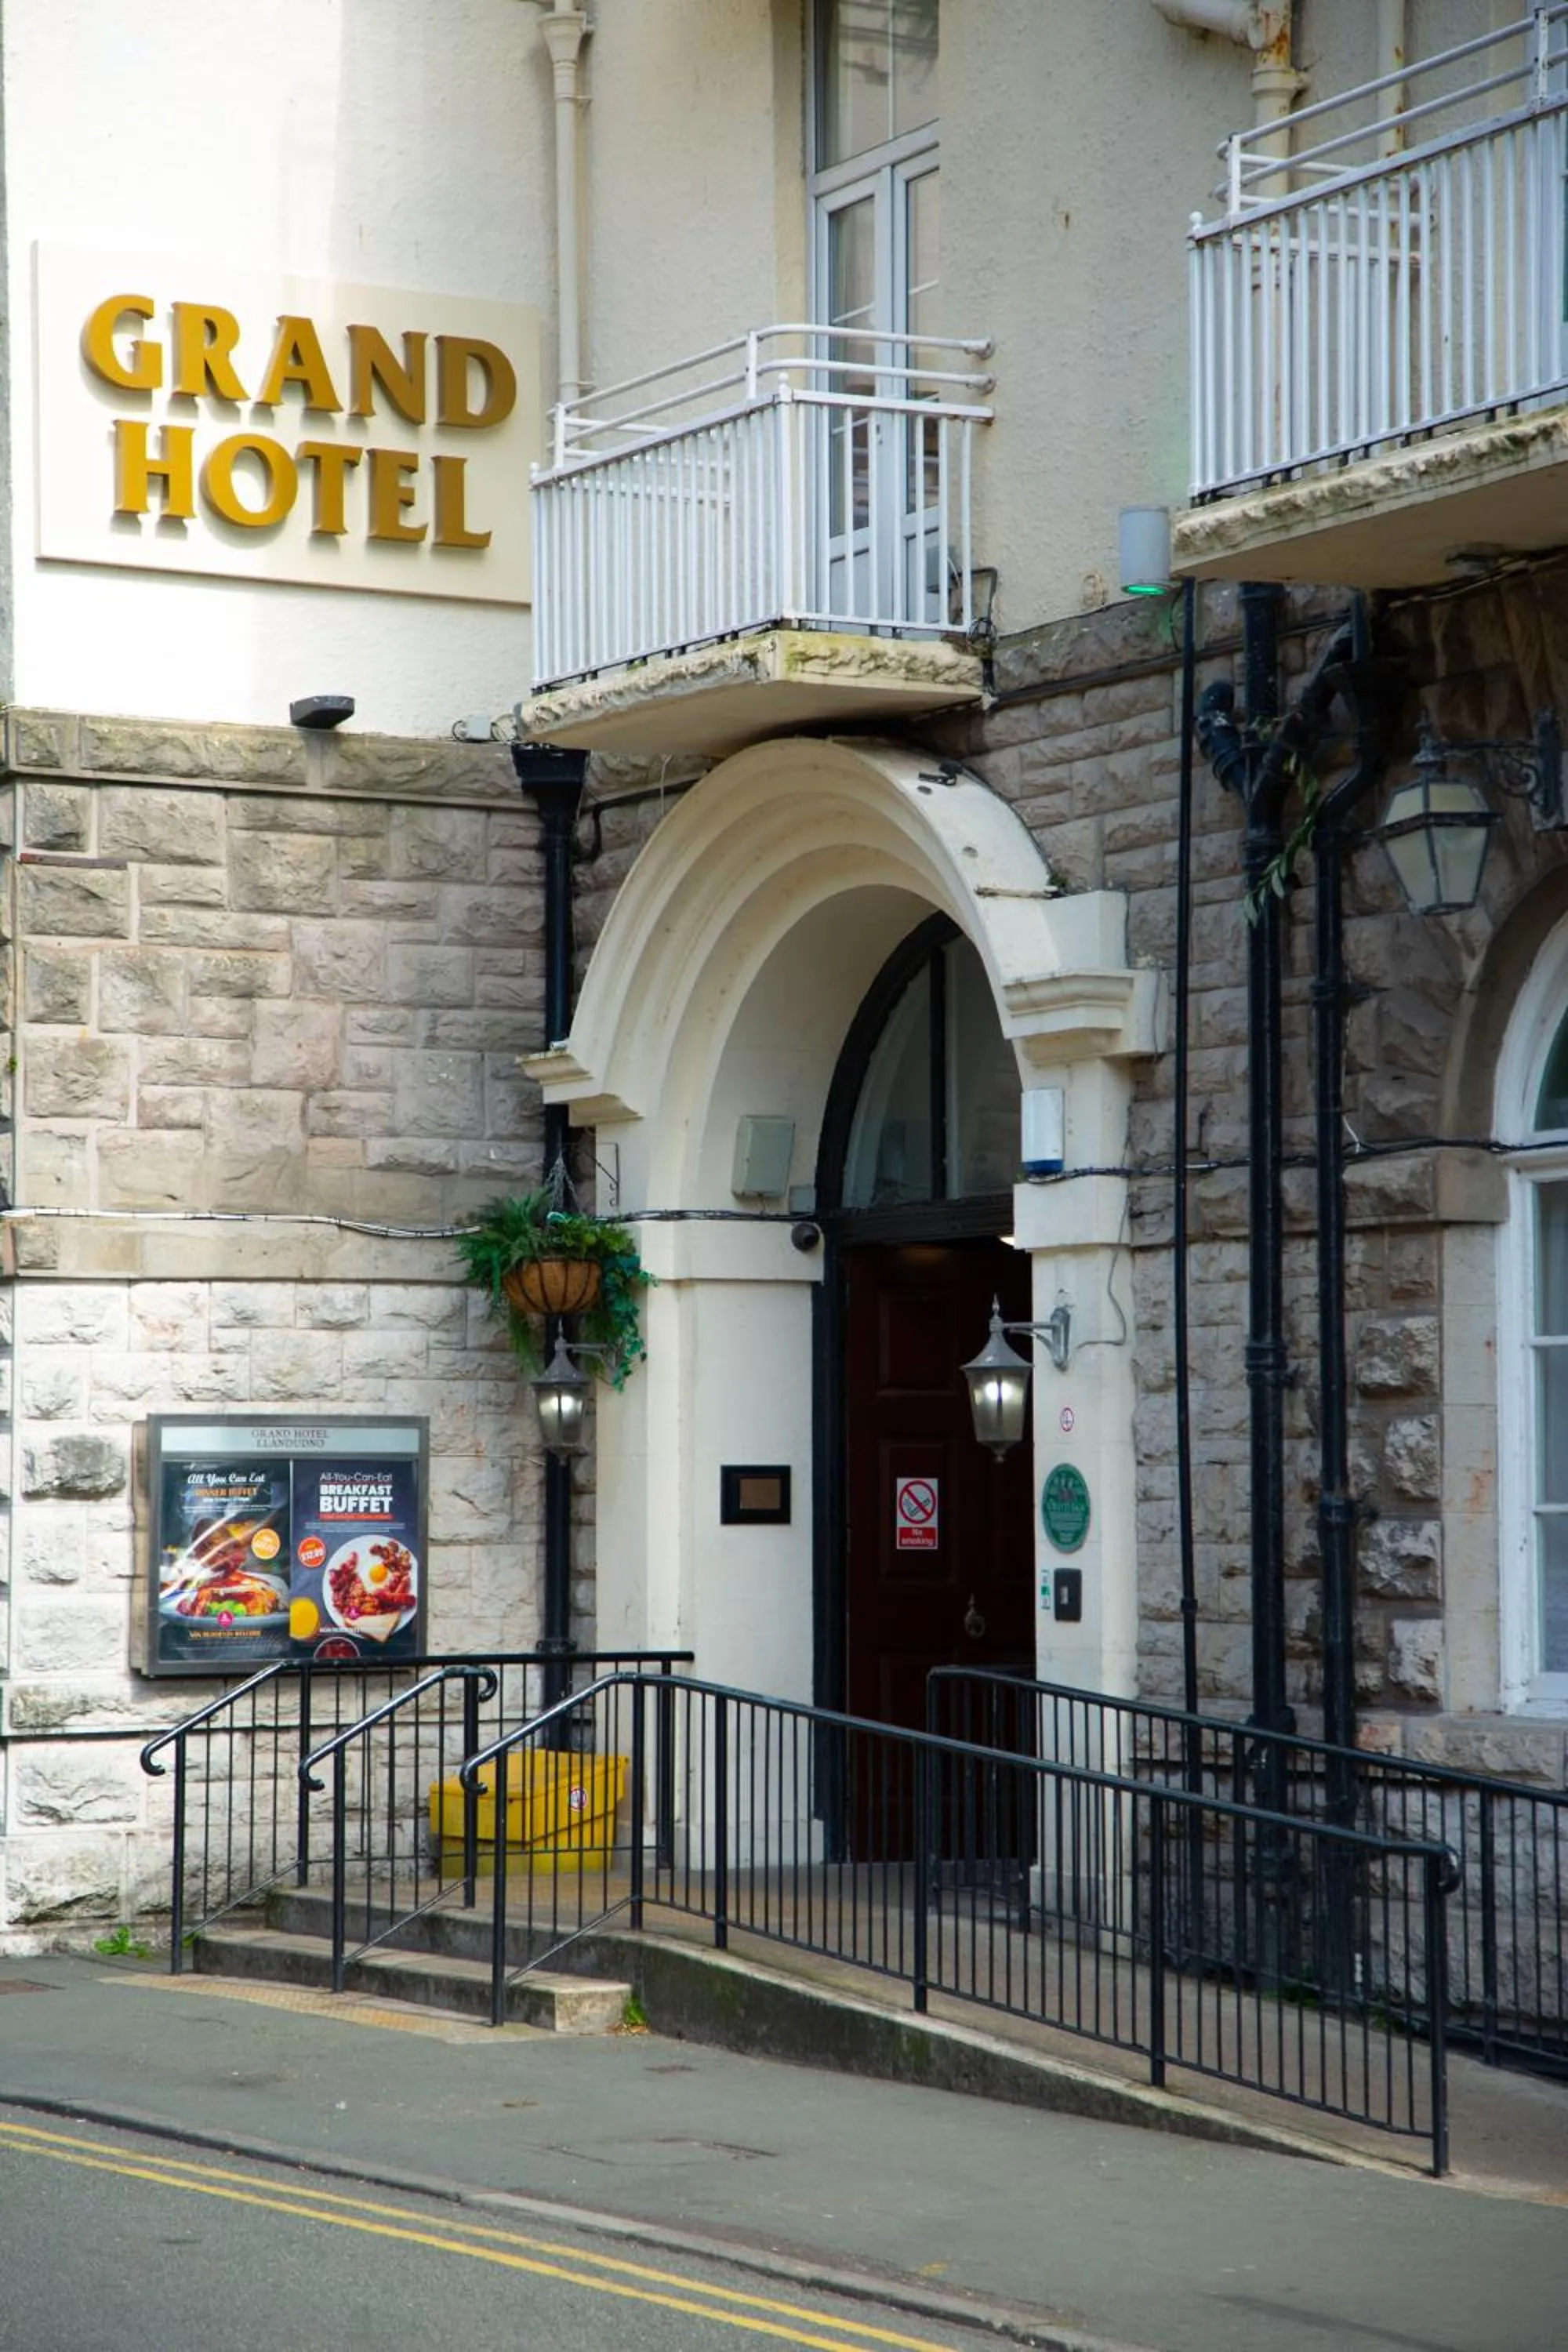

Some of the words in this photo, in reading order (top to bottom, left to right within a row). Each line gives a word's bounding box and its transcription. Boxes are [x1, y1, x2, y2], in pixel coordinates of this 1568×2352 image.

[83, 294, 517, 428] GRAND
[113, 419, 492, 550] HOTEL
[252, 1429, 291, 1439] GRAND
[294, 1429, 328, 1439] HOTEL
[256, 1439, 325, 1448] LLANDUDNO
[187, 1473, 204, 1484] All
[205, 1473, 227, 1486] You
[229, 1473, 247, 1483] Can
[249, 1472, 265, 1483] Eat
[320, 1484, 393, 1495] BREAKFAST
[319, 1496, 394, 1513] BUFFET
